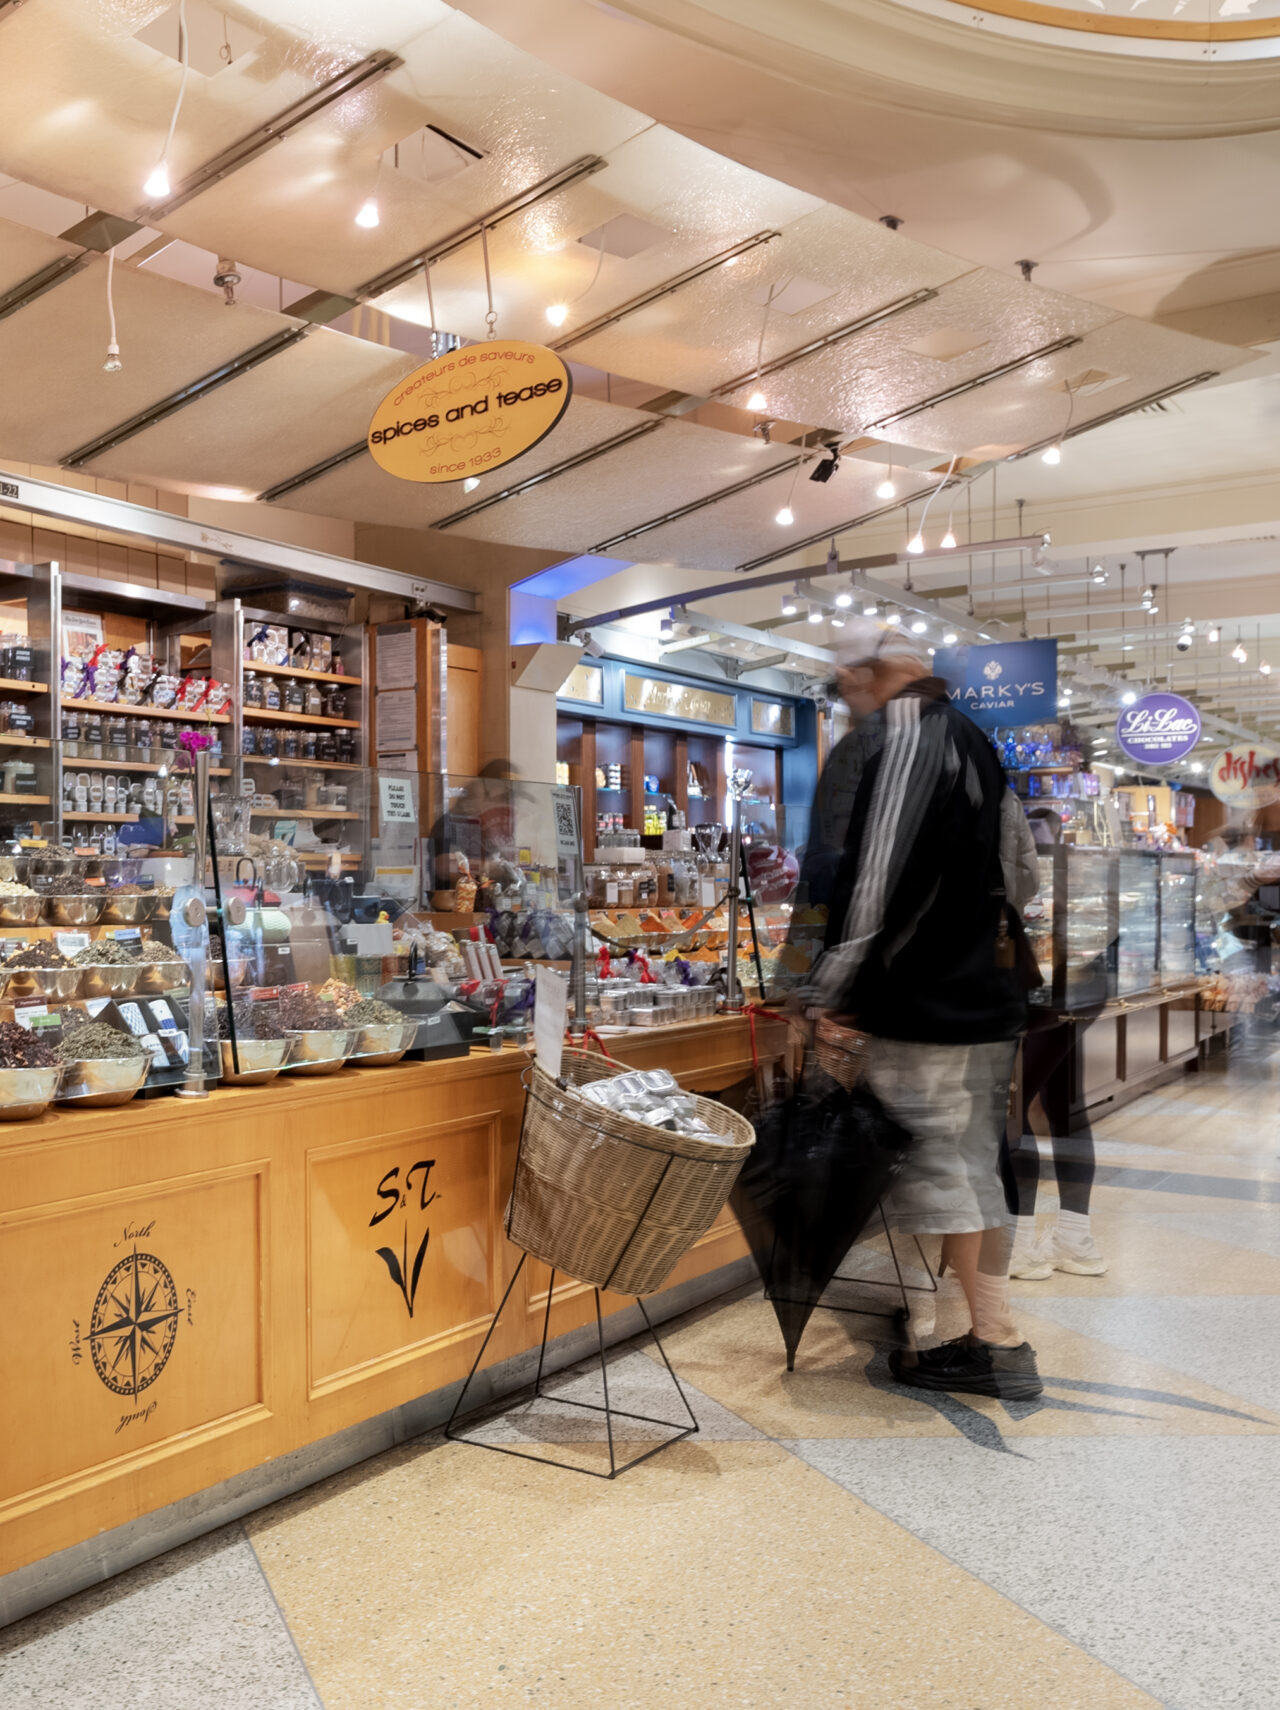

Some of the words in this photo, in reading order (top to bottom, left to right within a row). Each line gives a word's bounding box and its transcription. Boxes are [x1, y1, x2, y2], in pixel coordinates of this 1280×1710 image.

[393, 362, 456, 407] createurs
[458, 353, 477, 368] de
[479, 350, 536, 364] saveurs
[370, 413, 440, 445] spices
[445, 395, 489, 423] and
[496, 378, 563, 408] tease
[429, 461, 466, 475] since
[469, 447, 502, 467] 1933
[944, 682, 1045, 700] MARKY'S
[970, 700, 1015, 710] CAVIAR
[1120, 707, 1198, 735] Li-Lac
[1127, 735, 1189, 744] CHOCOLATES
[113, 1220, 157, 1248] North
[185, 1287, 198, 1326] East
[69, 1319, 83, 1366] West
[115, 1400, 158, 1434] South
